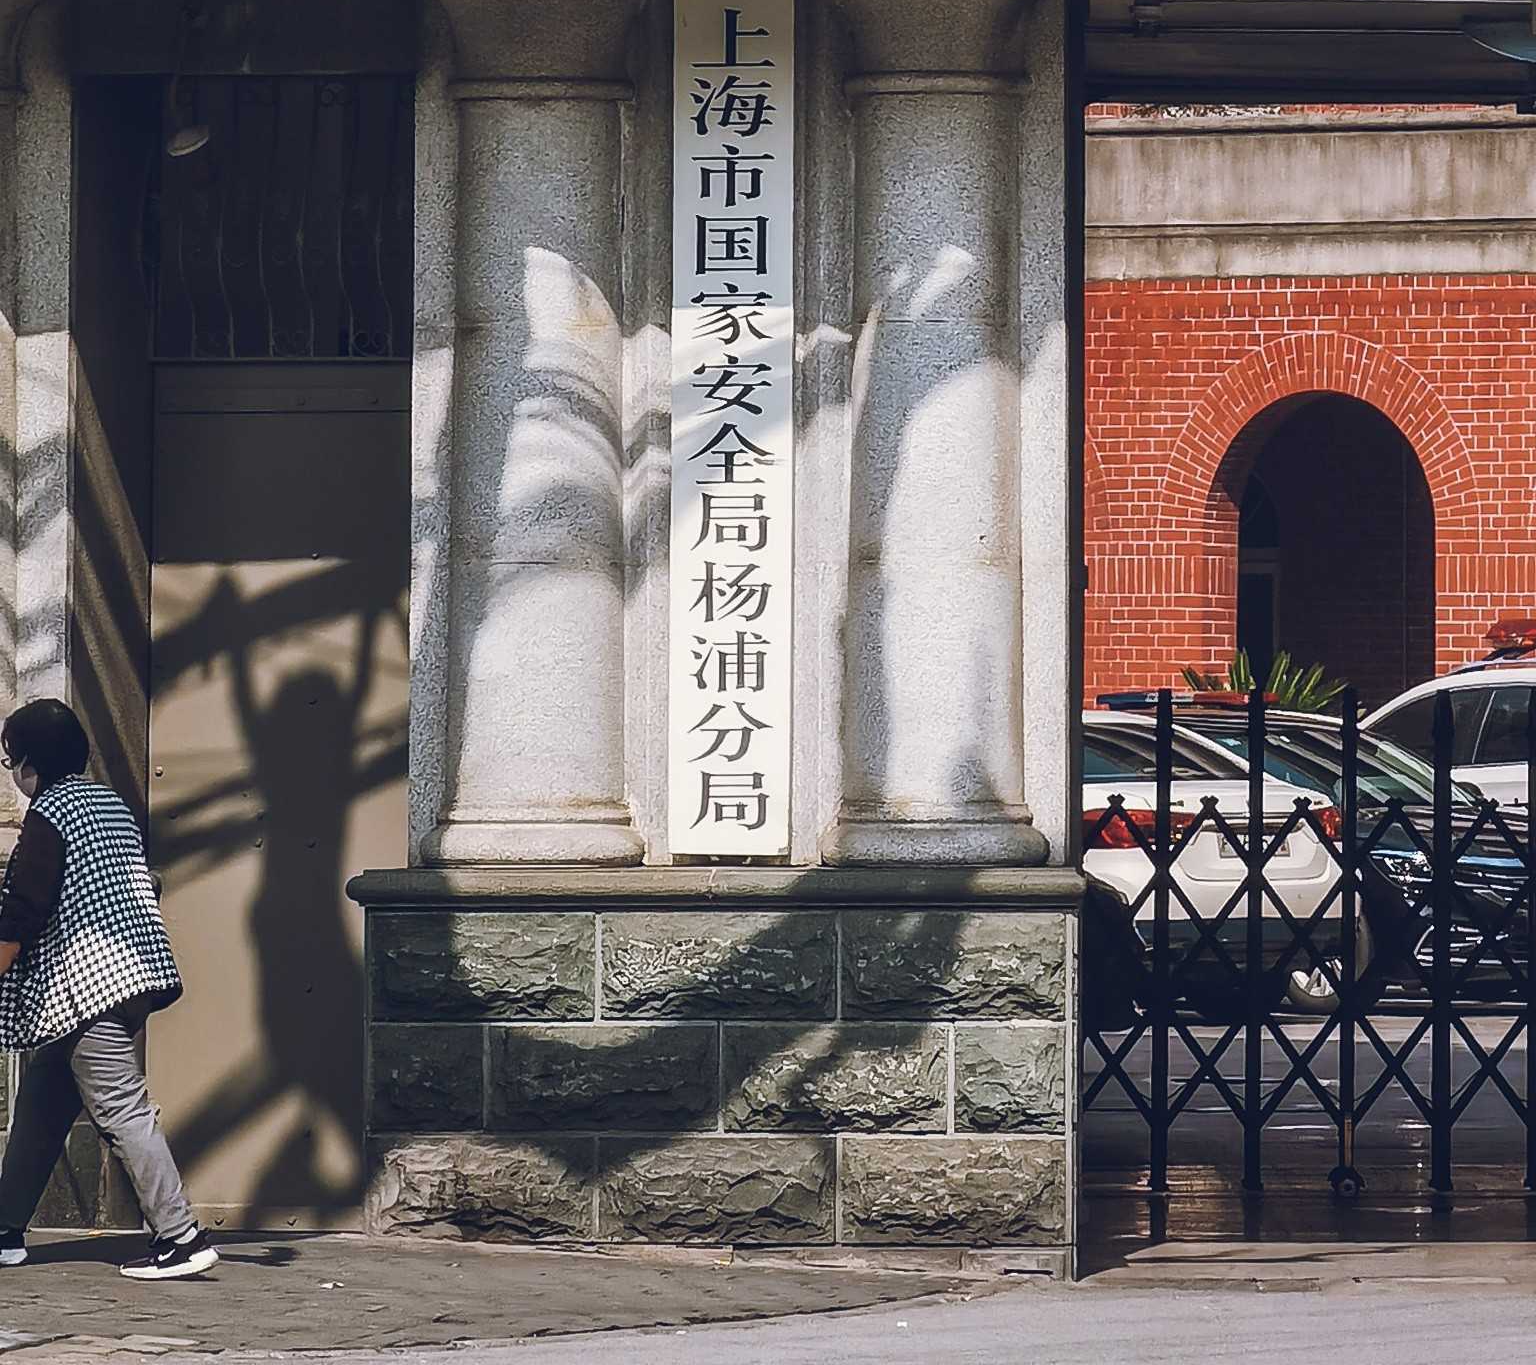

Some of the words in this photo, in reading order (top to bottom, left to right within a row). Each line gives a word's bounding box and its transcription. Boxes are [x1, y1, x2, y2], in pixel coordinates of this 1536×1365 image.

[687, 7, 776, 830] 上海市国家安全局杨浦分局
